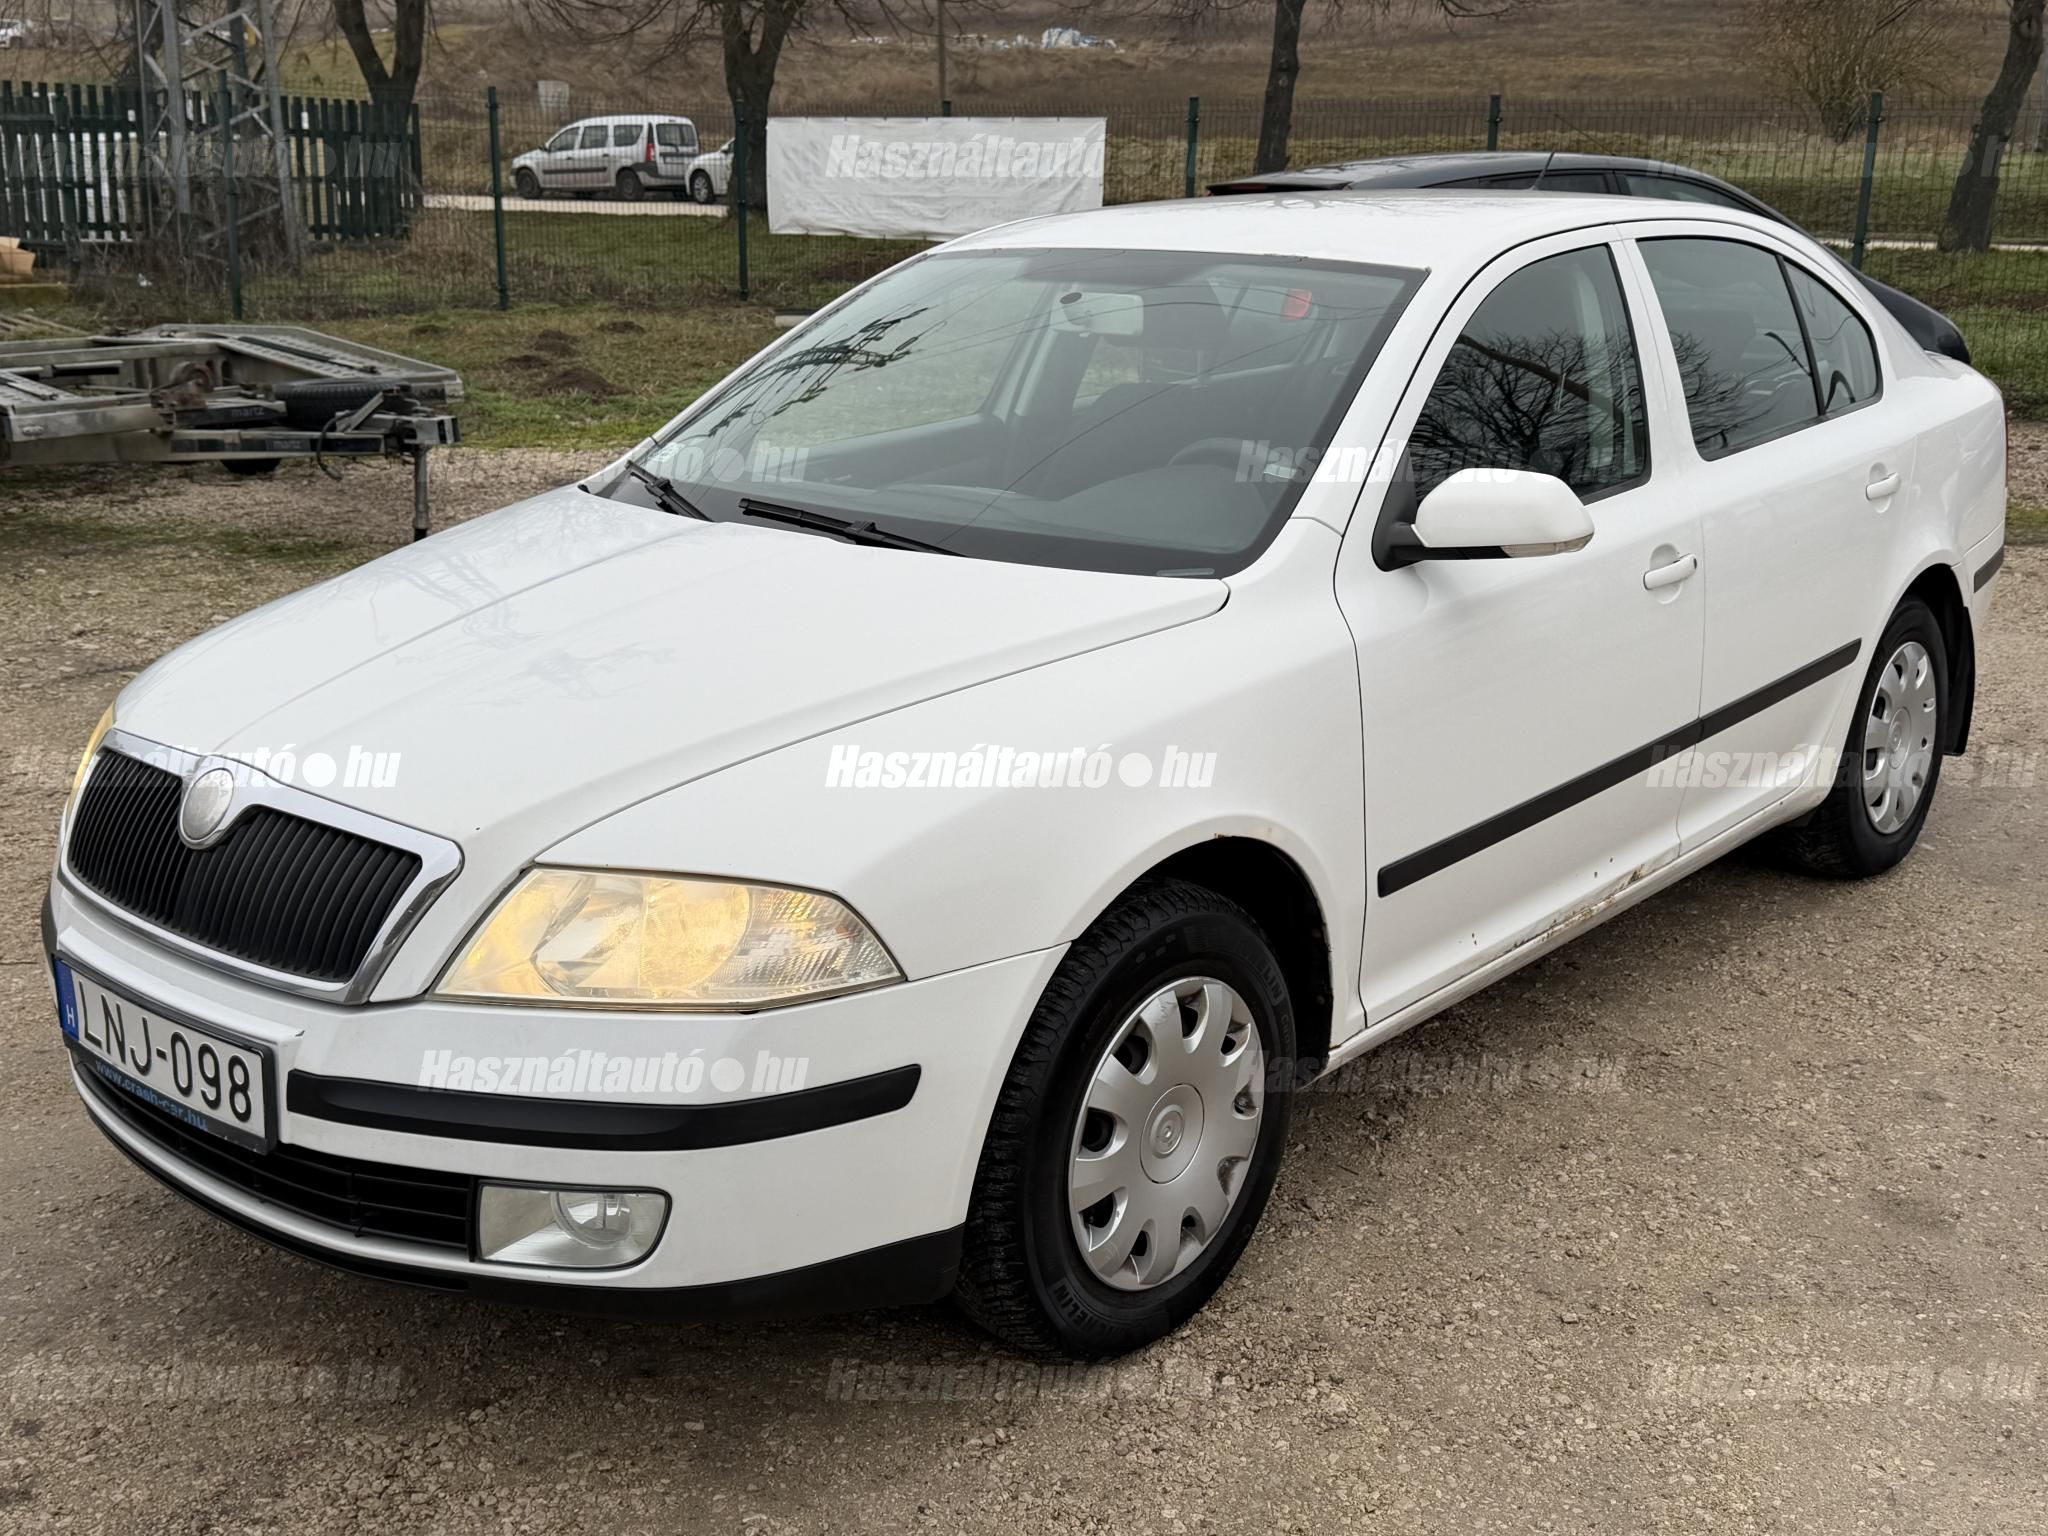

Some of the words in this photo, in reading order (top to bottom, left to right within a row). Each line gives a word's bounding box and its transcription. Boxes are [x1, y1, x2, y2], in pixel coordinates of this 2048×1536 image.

[65, 1003, 77, 1028] H
[78, 980, 252, 1124] LNJ-098
[95, 1059, 210, 1132] www.crash-car.hu
